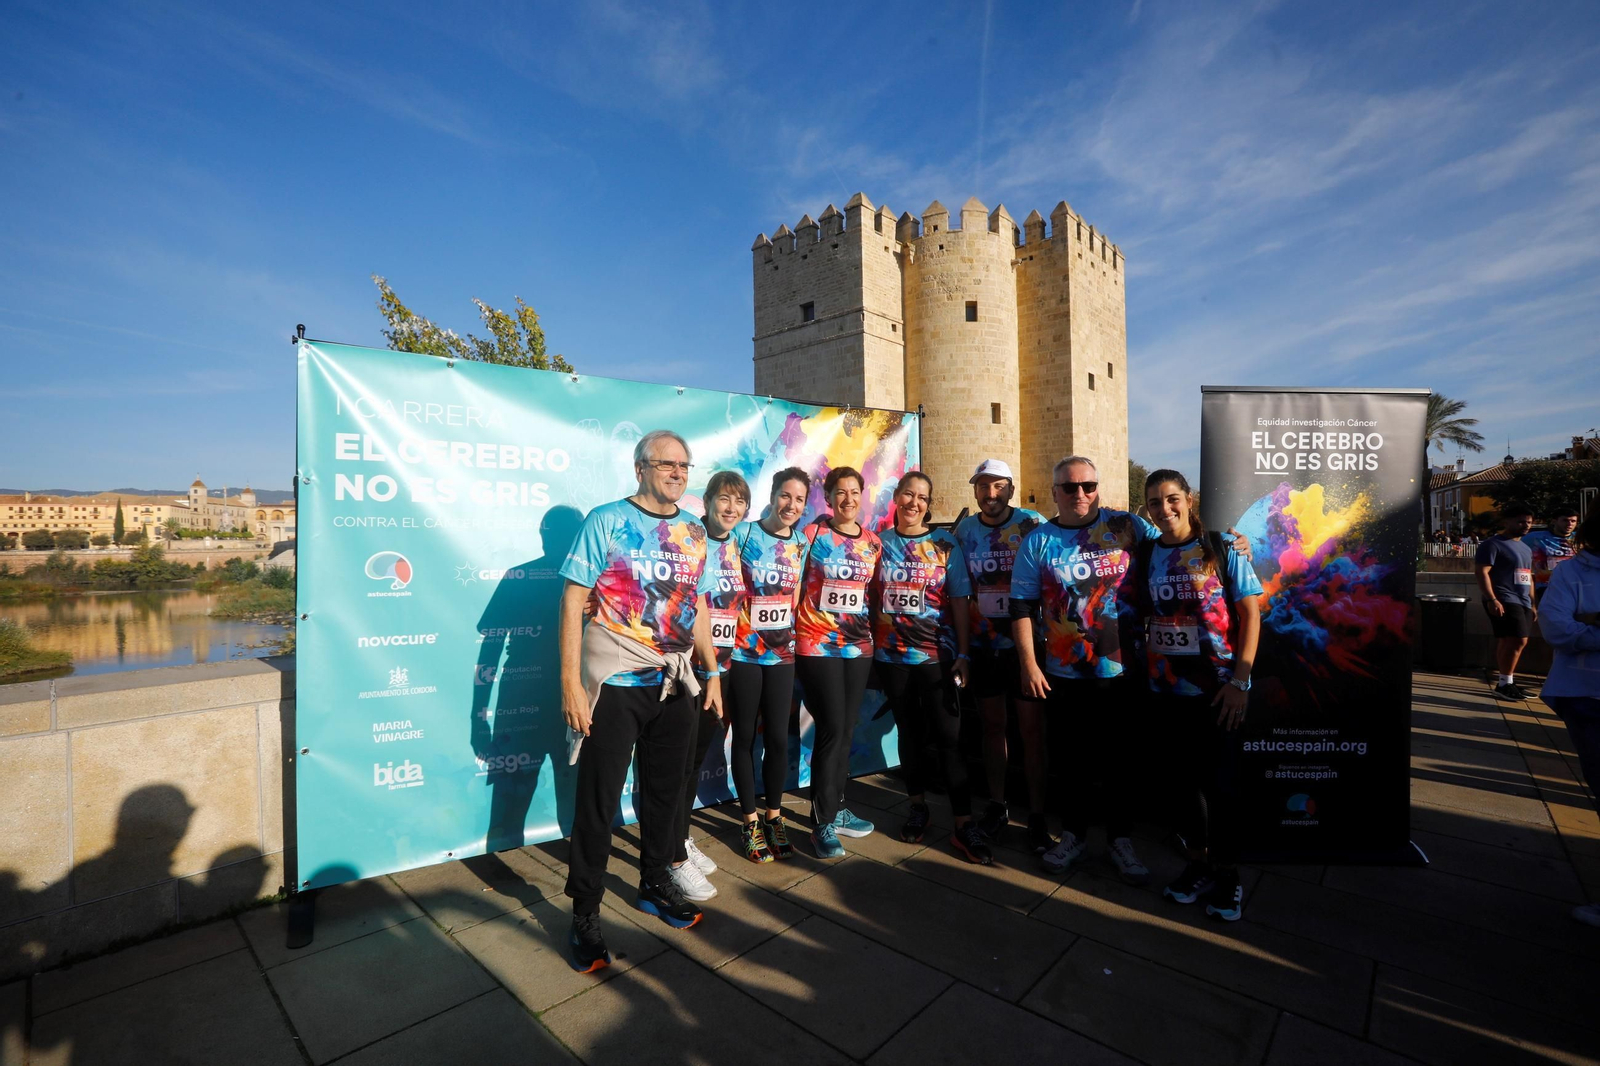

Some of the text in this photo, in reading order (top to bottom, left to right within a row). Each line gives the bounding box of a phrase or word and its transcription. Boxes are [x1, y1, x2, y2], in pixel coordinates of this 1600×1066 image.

[355, 397, 507, 429] CARRERA
[1257, 418, 1378, 428] Equidad investigación Cáncer
[1252, 432, 1384, 450] EL CEREBRO
[335, 432, 570, 472] EL CEREBRO
[1256, 452, 1379, 471] NO ES GRIS
[335, 473, 551, 507] NO ES GRIS
[333, 516, 397, 528] CONTRA
[402, 517, 419, 528] EL
[631, 549, 700, 564] EL CEREBRO
[981, 550, 1017, 558] CEREBR
[1051, 548, 1123, 566] EL CEREBRO
[674, 563, 690, 573] ES
[766, 562, 800, 574] CEREBR
[837, 558, 875, 569] CEREBR
[970, 558, 998, 572] NO
[1000, 564, 1013, 572] GR
[1093, 558, 1110, 569] ES
[479, 569, 526, 580] GEINO
[632, 560, 671, 581] NO
[714, 569, 742, 577] CEREBR
[752, 568, 779, 585] NO
[823, 564, 852, 580] NO
[855, 567, 867, 575] ES
[879, 567, 907, 582] NO
[911, 569, 926, 577] ES
[1054, 562, 1091, 584] NO
[1095, 564, 1125, 577] GRIS
[673, 573, 698, 585] GRIS
[729, 577, 740, 585] ES
[782, 573, 794, 581] ES
[1156, 574, 1206, 584] CEREBRO
[1176, 583, 1192, 592] ES
[828, 592, 858, 606] 819
[889, 593, 919, 607] 756
[1177, 591, 1205, 600] GRIS
[758, 609, 788, 622] 807
[480, 626, 542, 637] SERVIER
[358, 633, 437, 647] novocure
[1156, 631, 1189, 647] 333
[501, 665, 541, 674] Diputación
[358, 689, 401, 699] AYUNTAMIENTO
[402, 688, 411, 696] DE
[497, 705, 539, 716] Cruz Roja
[373, 730, 425, 744] VINAGRE
[1243, 738, 1367, 755] astucespain.org
[374, 760, 424, 786] bida
[1282, 819, 1319, 827] astucespain
